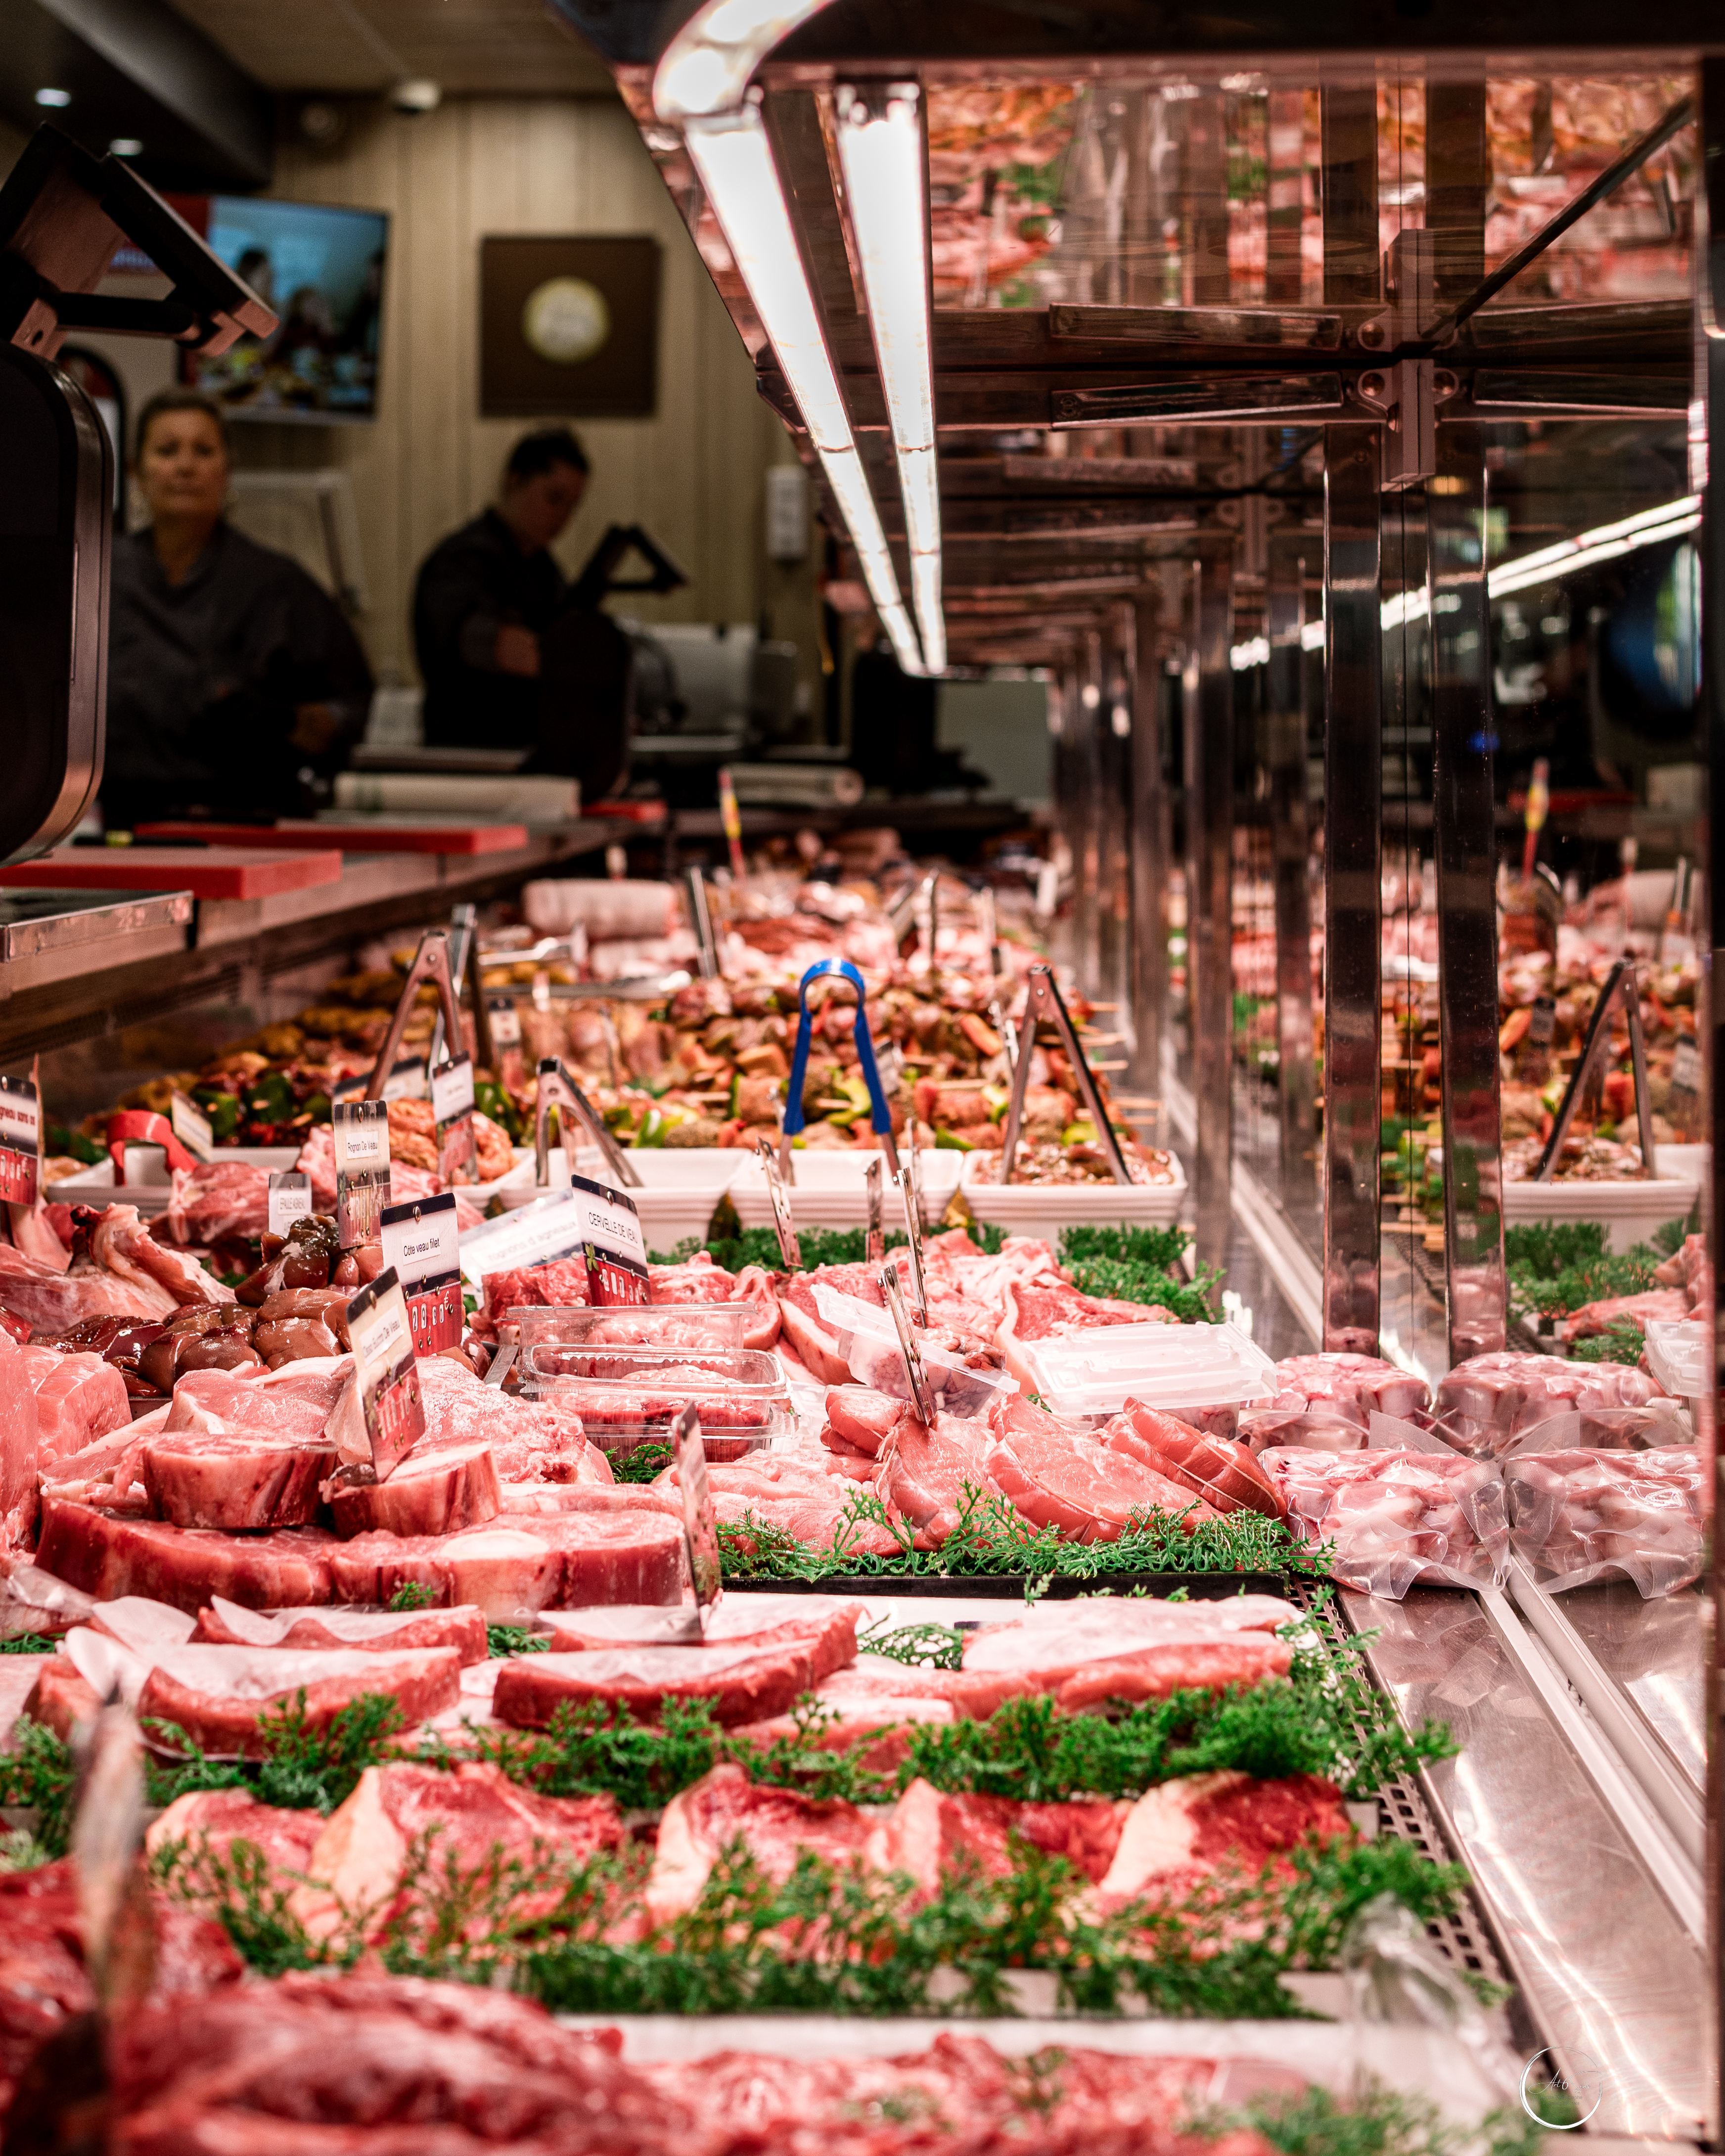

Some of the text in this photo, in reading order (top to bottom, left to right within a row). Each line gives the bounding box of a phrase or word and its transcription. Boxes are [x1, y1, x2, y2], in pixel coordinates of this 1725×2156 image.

[348, 1140, 378, 1153] Rognon De Veau
[589, 1212, 638, 1244] CERVELLE DE VEAU
[404, 1237, 440, 1257] Côte veau filet
